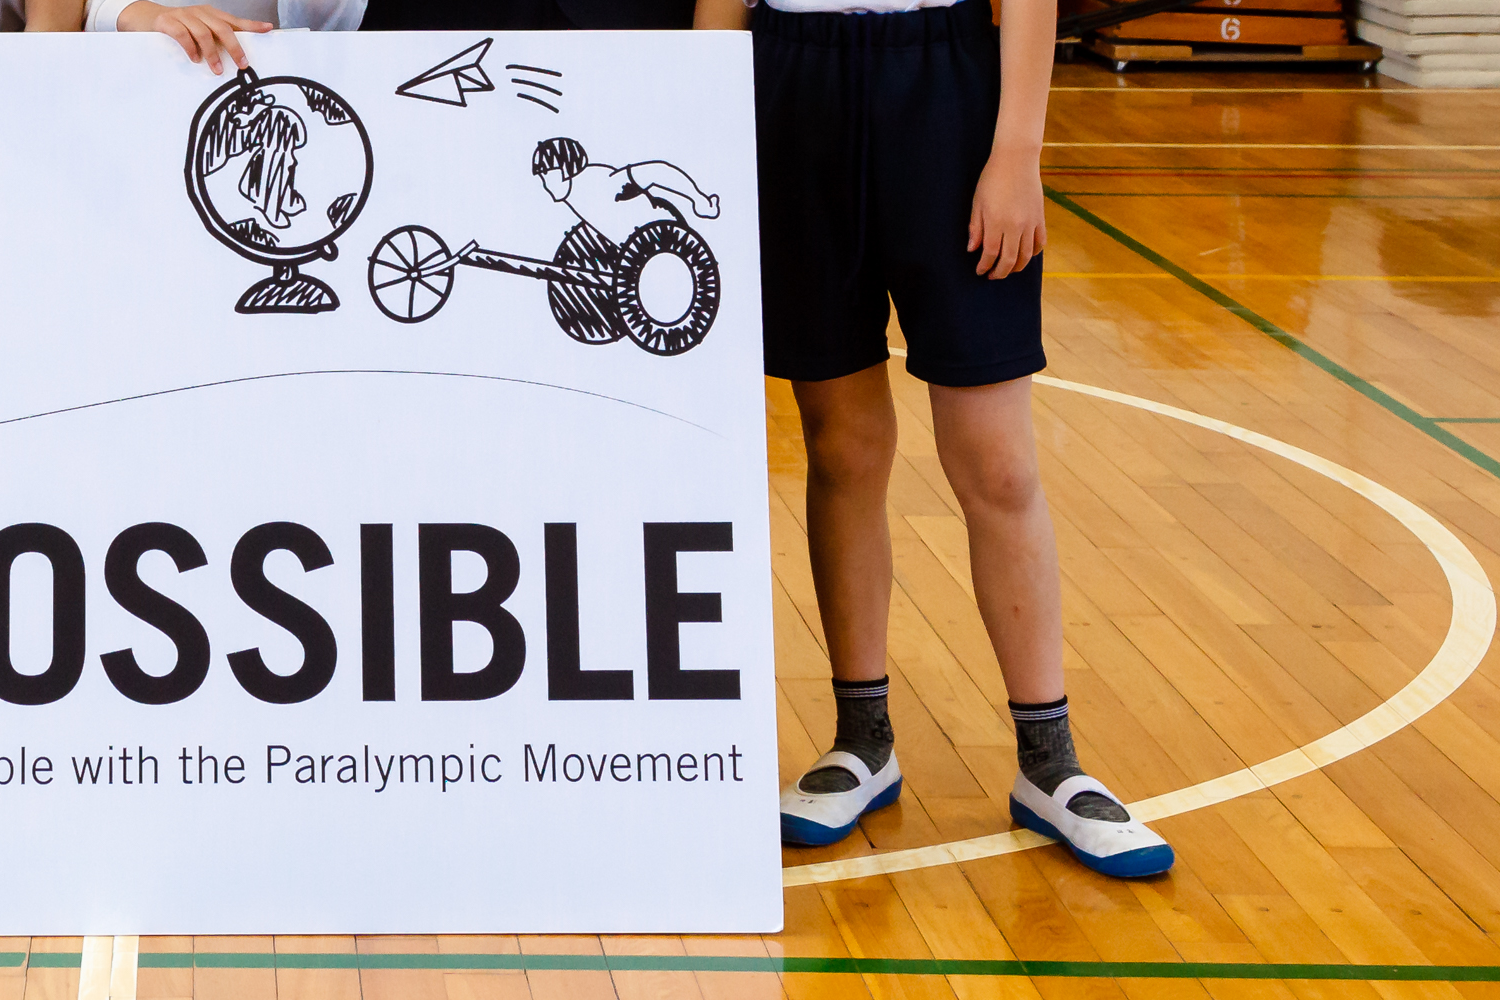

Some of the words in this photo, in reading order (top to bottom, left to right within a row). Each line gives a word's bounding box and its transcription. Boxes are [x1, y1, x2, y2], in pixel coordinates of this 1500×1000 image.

[1221, 17, 1241, 40] 6
[71, 745, 159, 785] with
[178, 745, 246, 785] the
[267, 743, 502, 793] Paralympic
[524, 743, 744, 783] Movement
